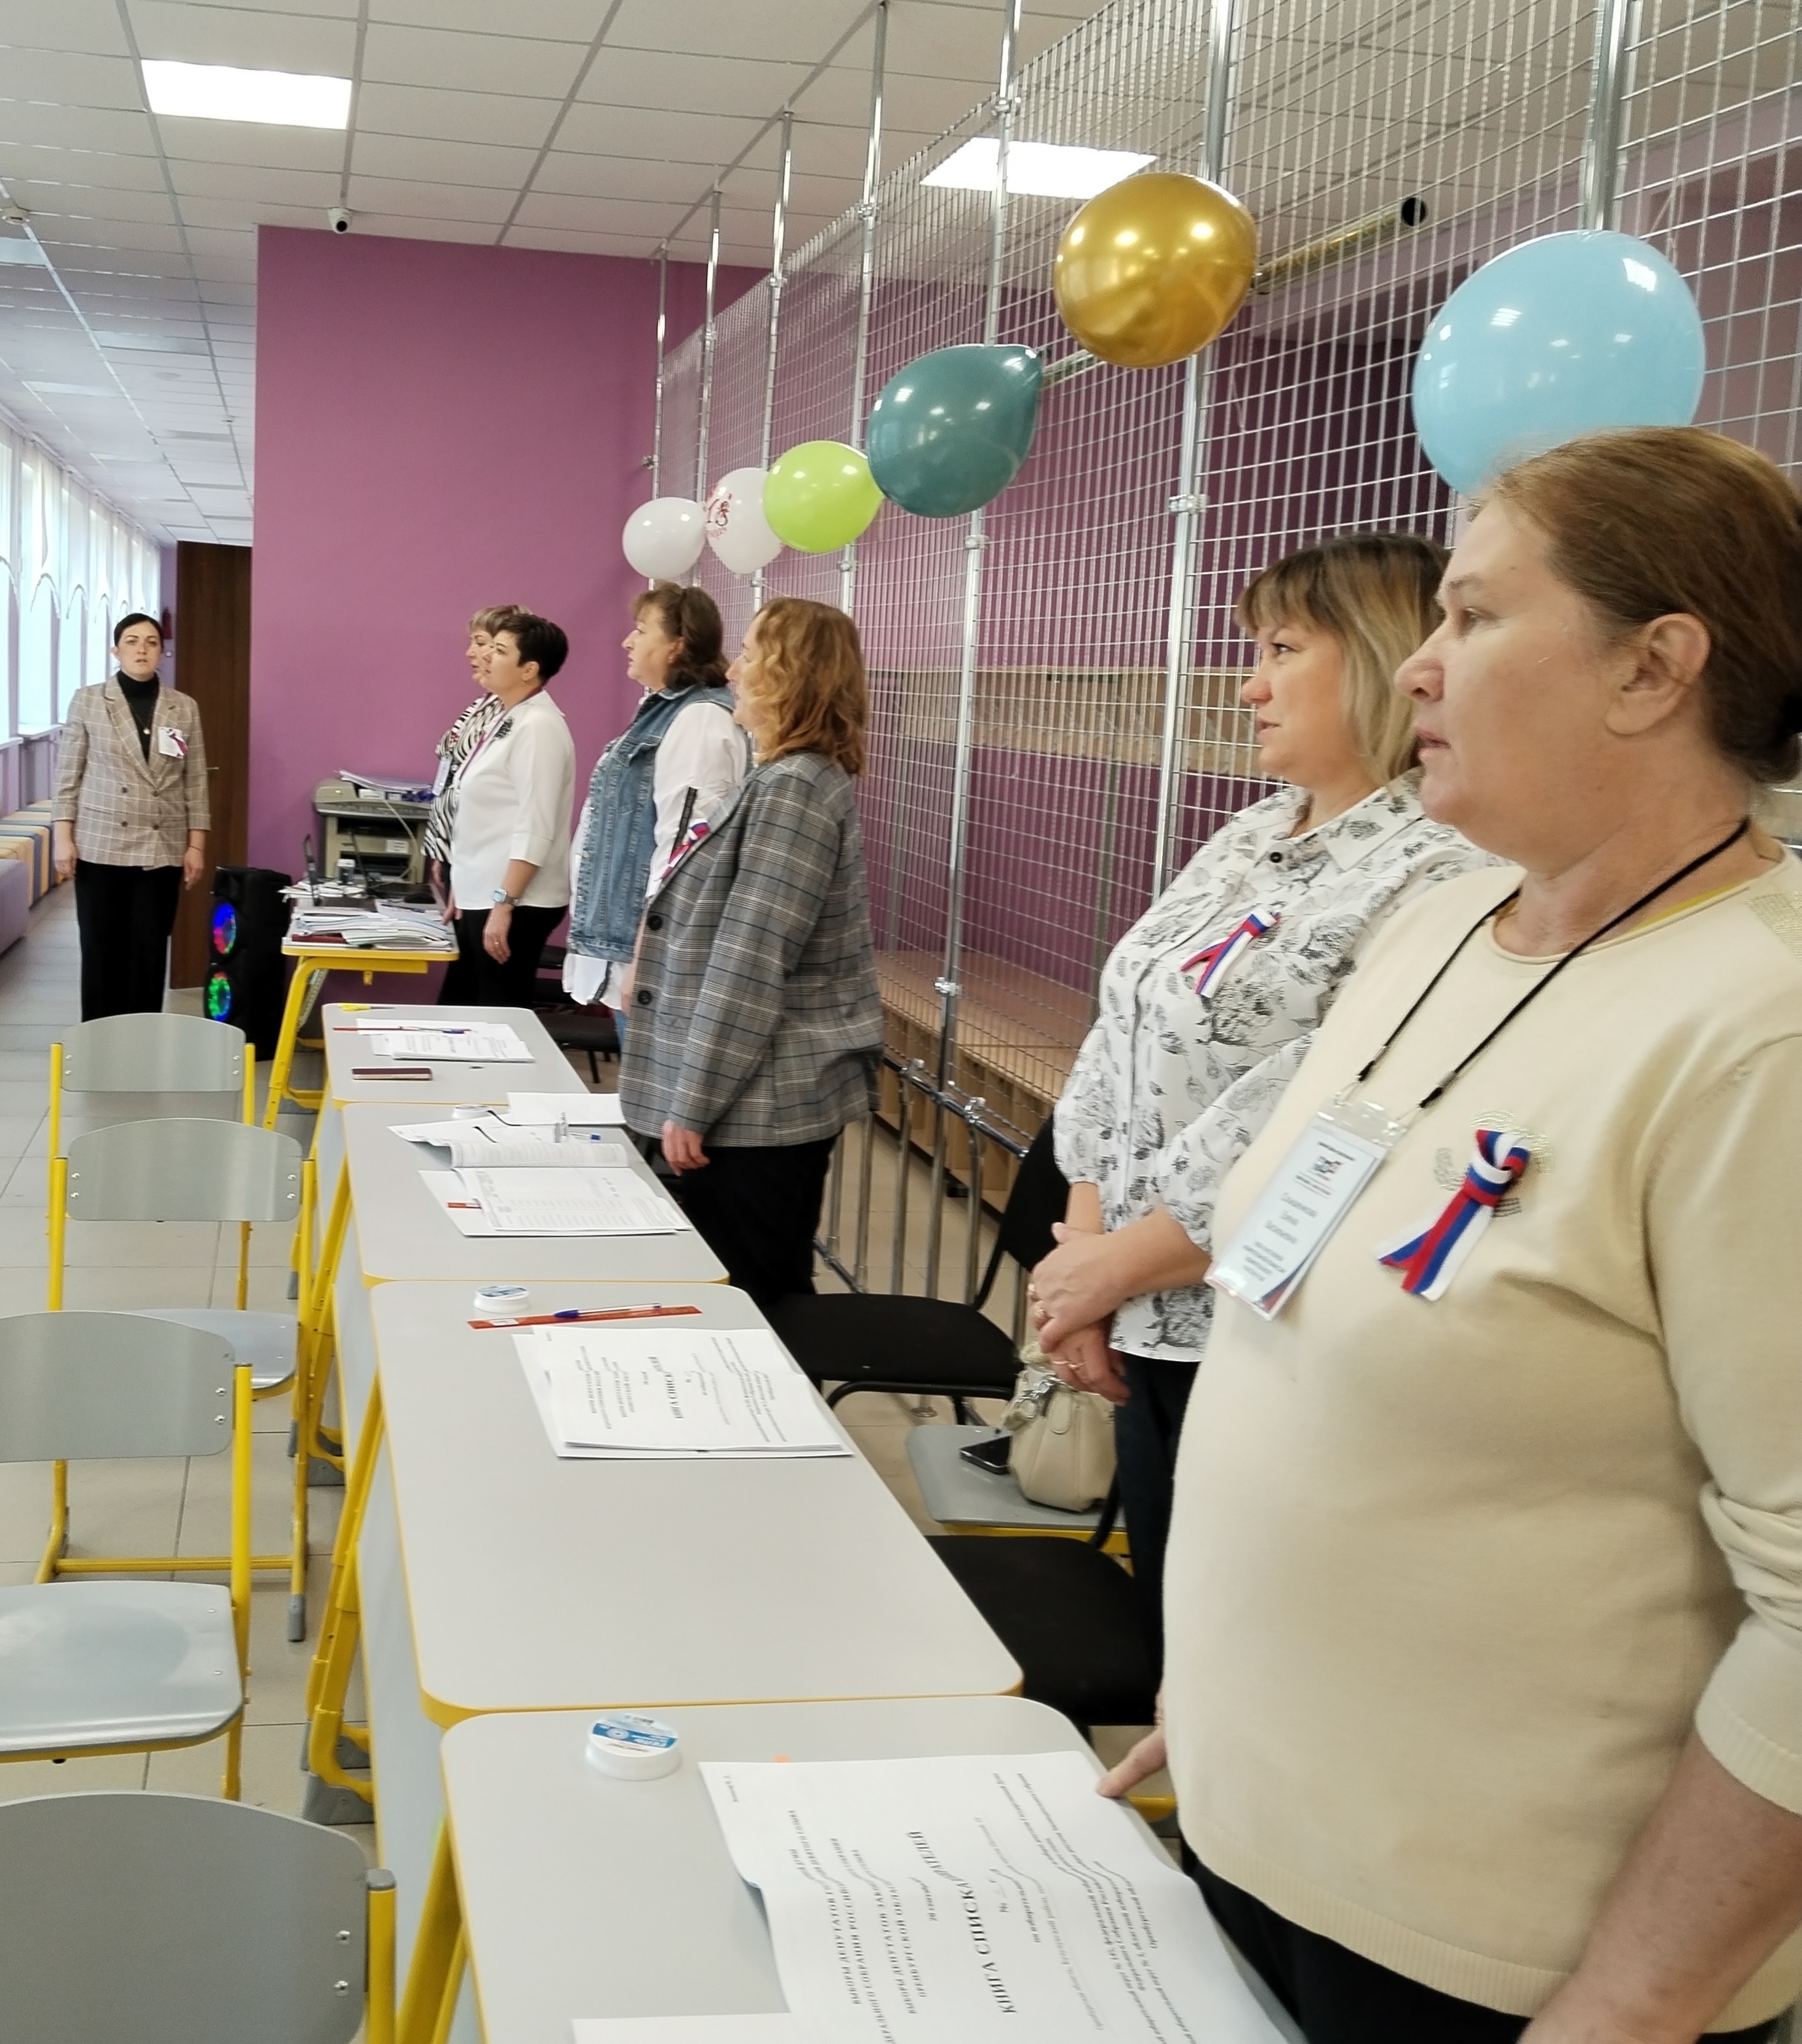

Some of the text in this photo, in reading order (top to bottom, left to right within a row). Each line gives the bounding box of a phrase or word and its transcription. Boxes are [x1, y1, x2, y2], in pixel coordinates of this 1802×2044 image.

[908, 1832, 964, 1881] РАТЕЛЕЙ
[828, 1898, 850, 1963] ДЕПУТАТОВ
[879, 1913, 904, 1975] ДЕПУТАТОВ
[957, 1882, 989, 1955] СПИСКА
[851, 1934, 872, 1988] СОБРАНИЯ
[894, 1920, 926, 1997] ОРЕНБУРГСКОЙ
[842, 1967, 861, 2005] ВЫБОРЫ
[895, 1979, 916, 2014] ВЫБОРЫ
[982, 1962, 1016, 2013] КНИГА
[866, 1992, 896, 2044] ДЕРАЛЬНОГО
